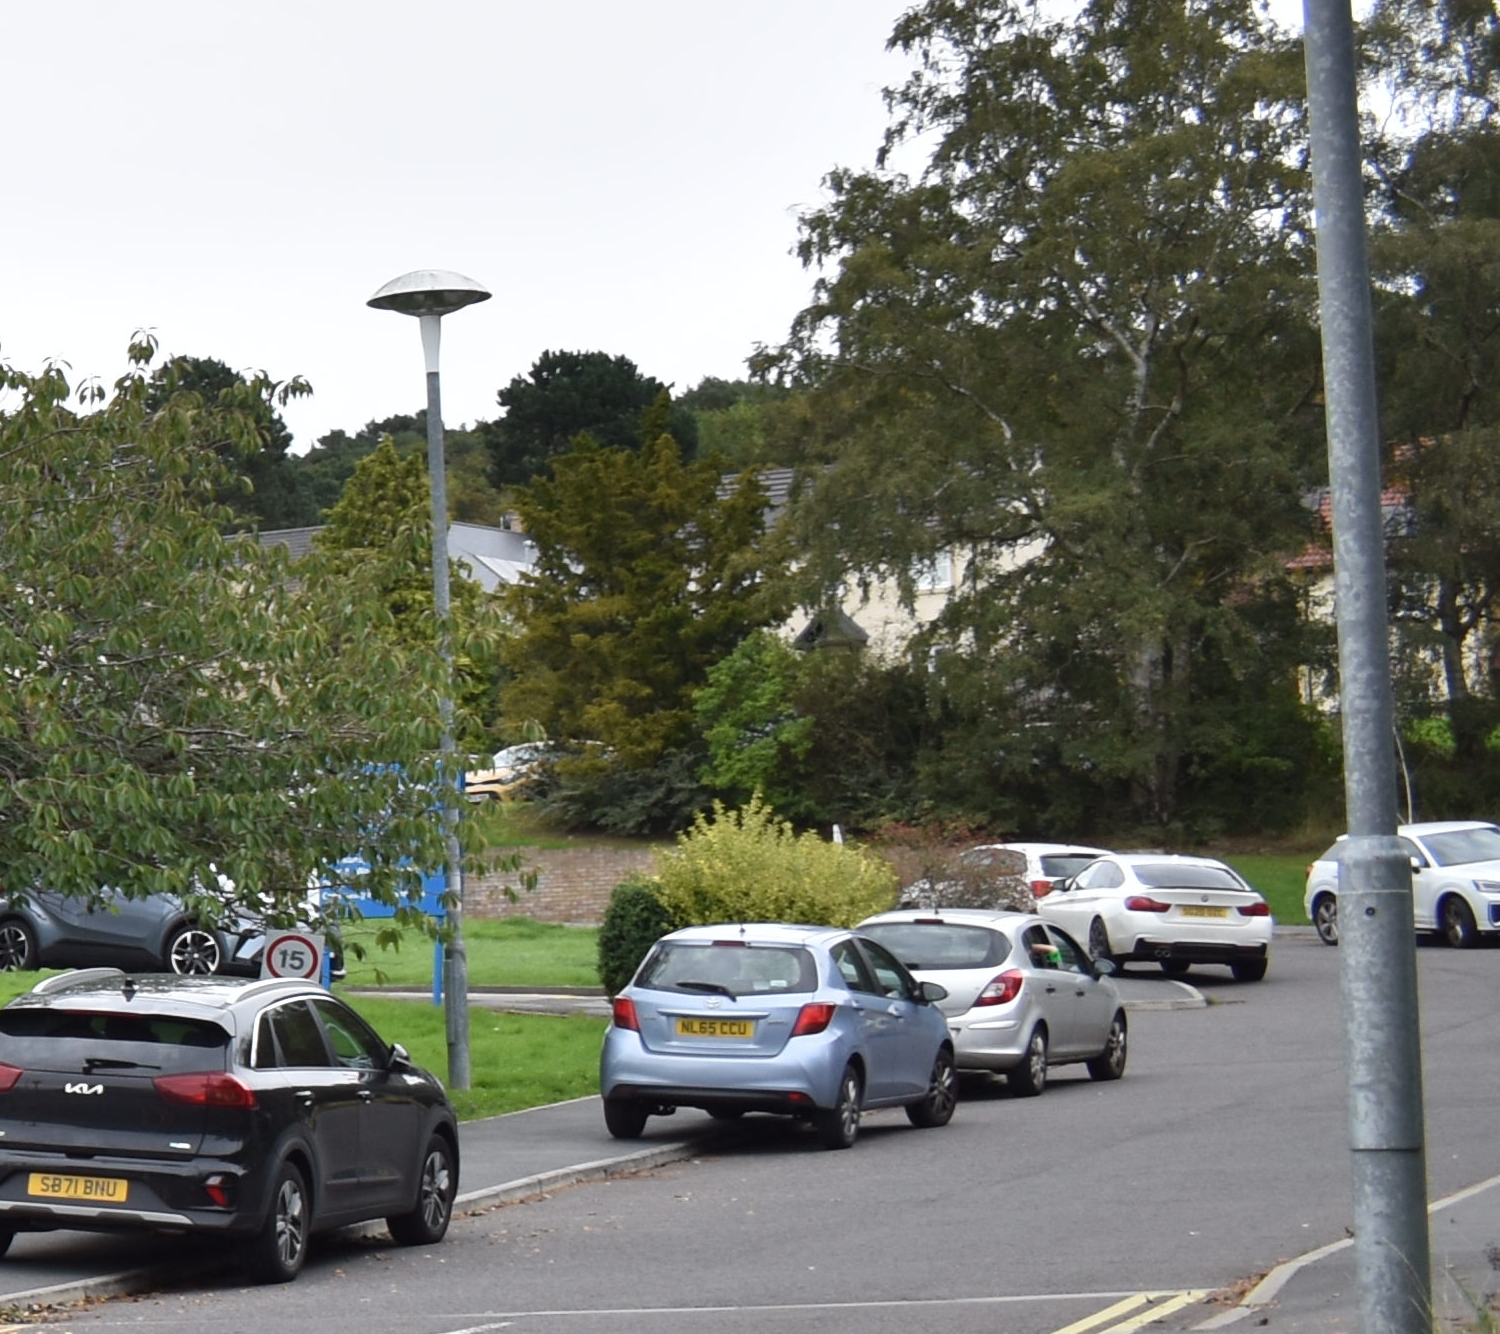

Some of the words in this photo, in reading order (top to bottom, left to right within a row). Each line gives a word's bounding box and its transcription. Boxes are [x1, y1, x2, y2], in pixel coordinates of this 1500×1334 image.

[278, 949, 305, 970] 15
[681, 1022, 716, 1035] NL65
[719, 1022, 747, 1035] CCU
[40, 1176, 78, 1194] SB71
[83, 1179, 117, 1197] BNU
